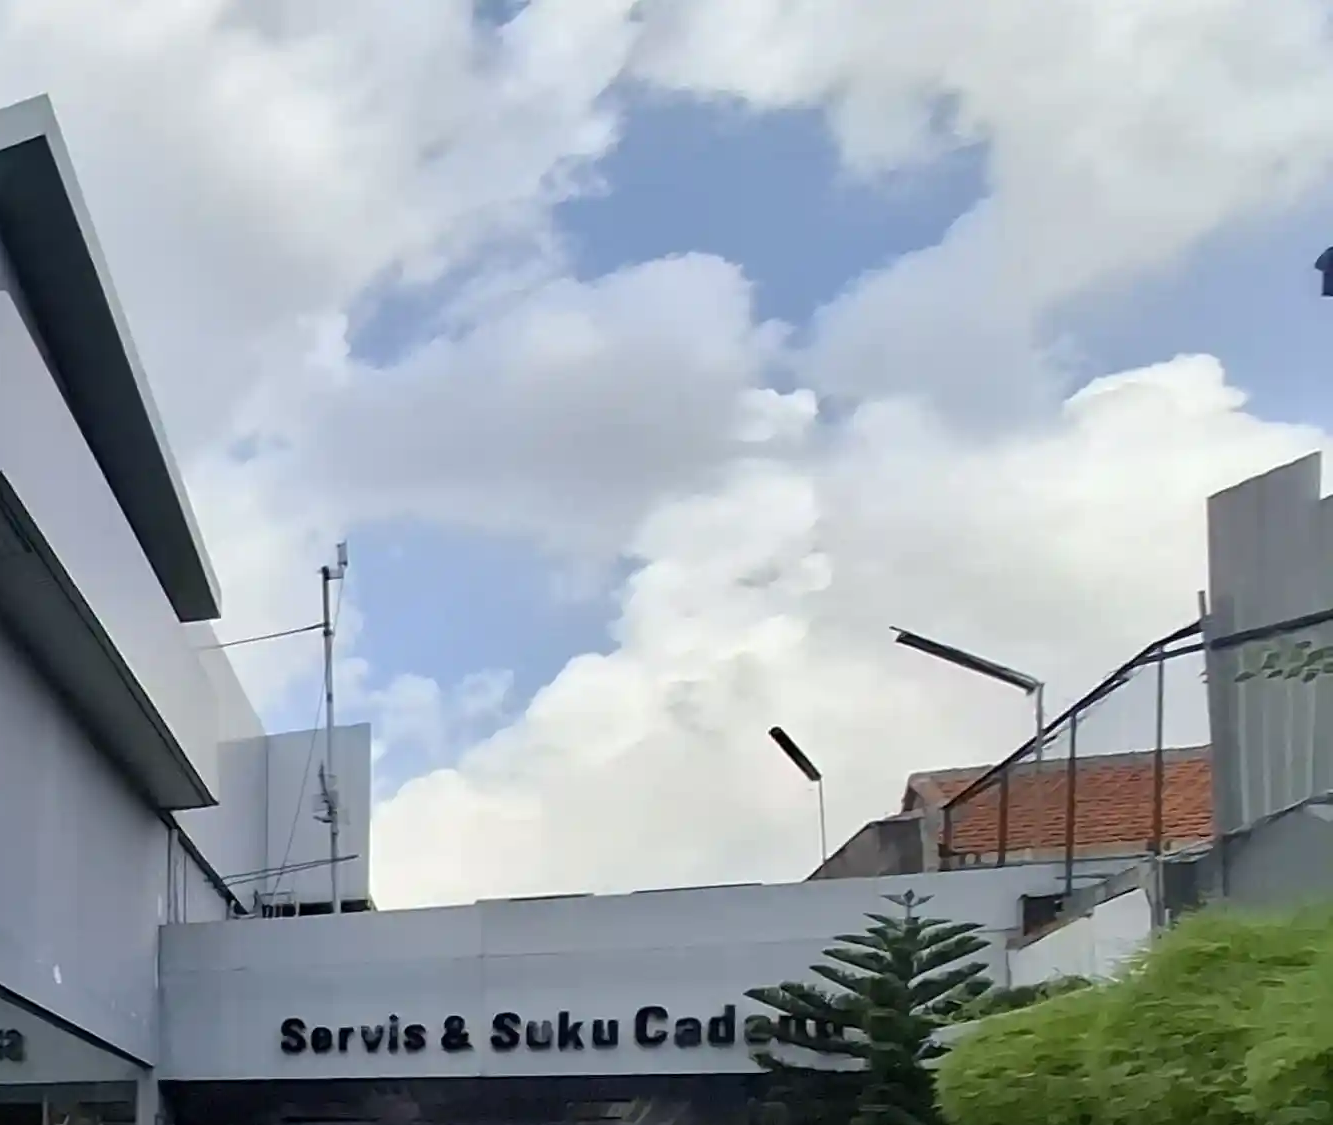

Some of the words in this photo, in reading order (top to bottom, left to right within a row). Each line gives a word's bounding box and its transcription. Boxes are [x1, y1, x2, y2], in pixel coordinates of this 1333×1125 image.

[279, 1013, 426, 1054] Servis
[440, 1014, 474, 1052] &
[490, 1010, 620, 1053] Suku
